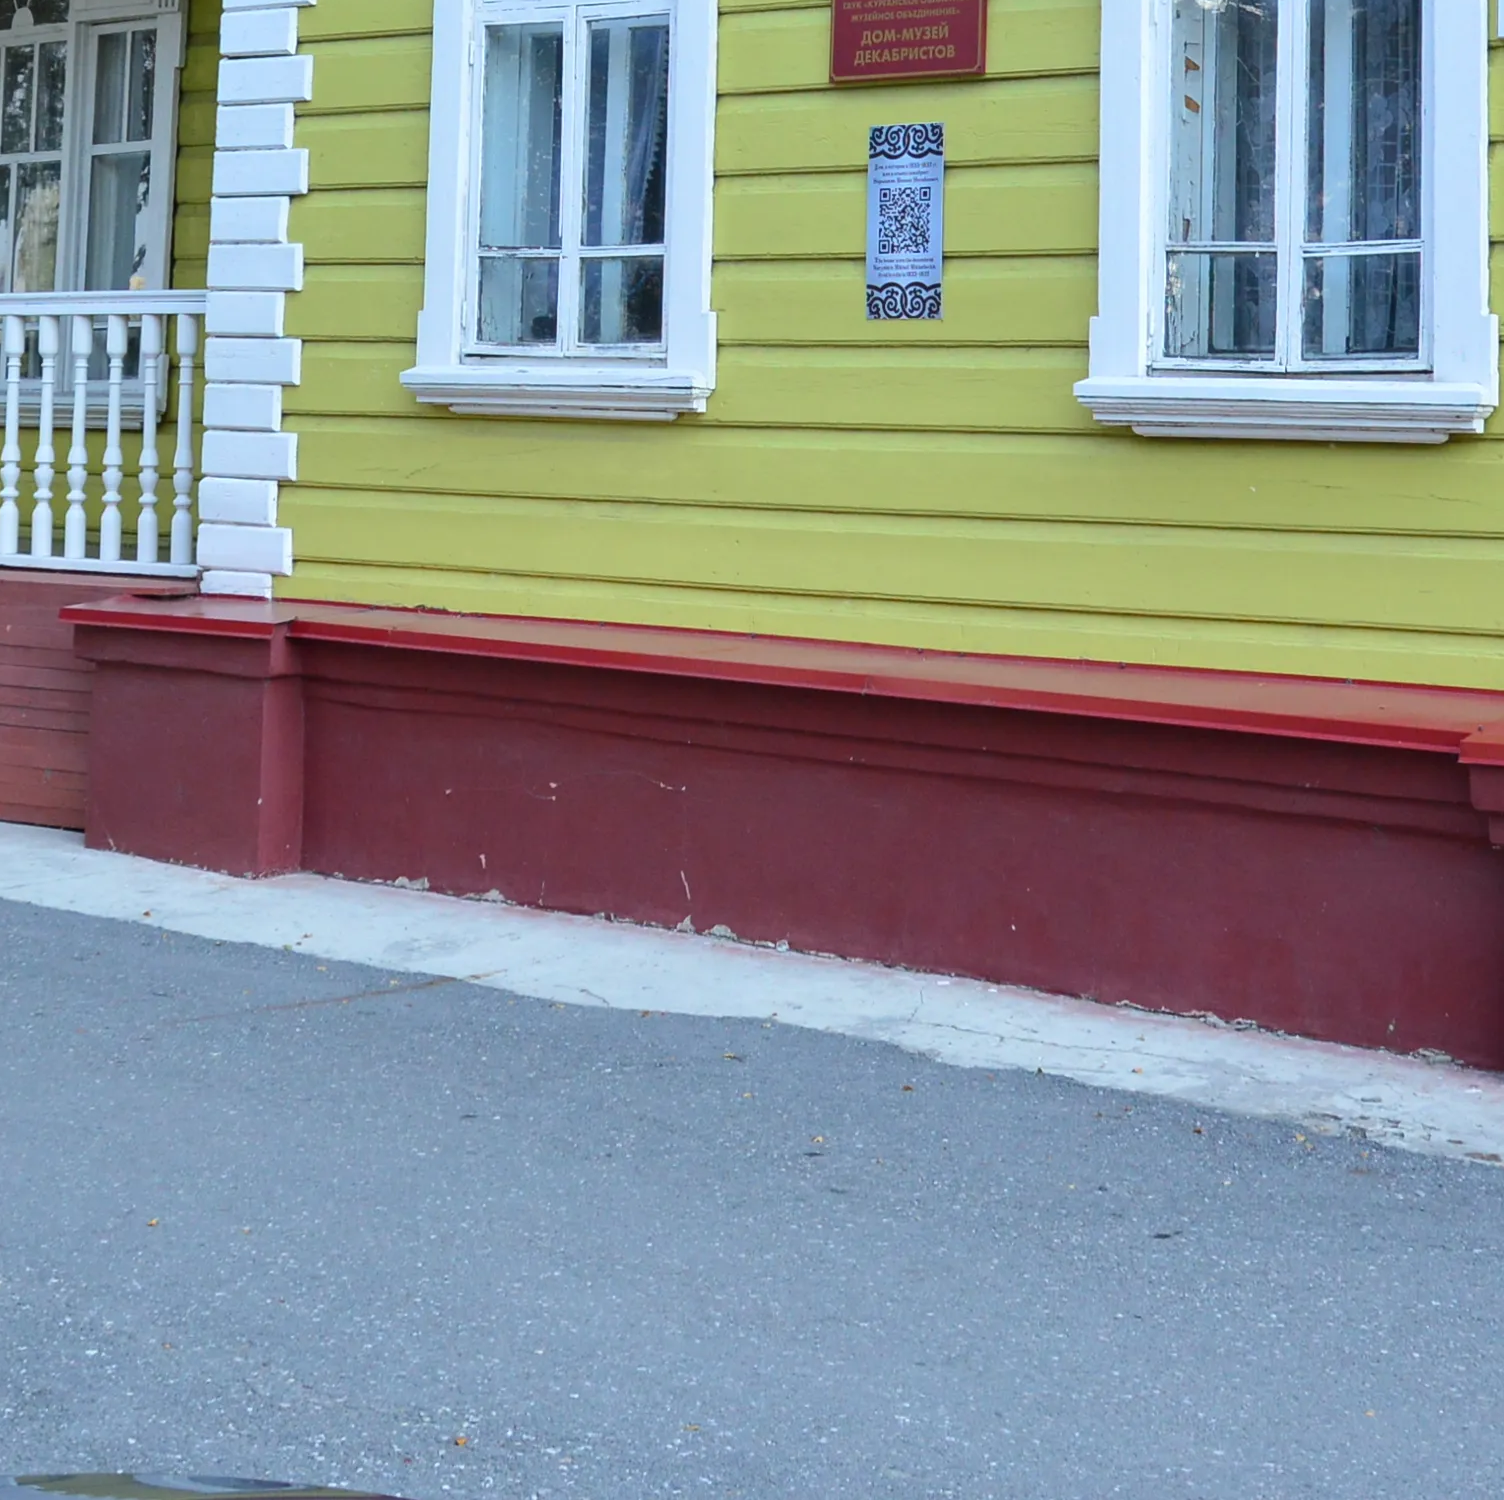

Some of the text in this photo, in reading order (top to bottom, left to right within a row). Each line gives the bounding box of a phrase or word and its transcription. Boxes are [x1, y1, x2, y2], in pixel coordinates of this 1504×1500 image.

[851, 7, 960, 22] МУЗЕЙНОЕ ОБЪЕДИНЕНИЕ»
[861, 22, 949, 46] ДОМ-МУЗЕЙ
[854, 45, 955, 66] ДЕКАБРИСТОВ
